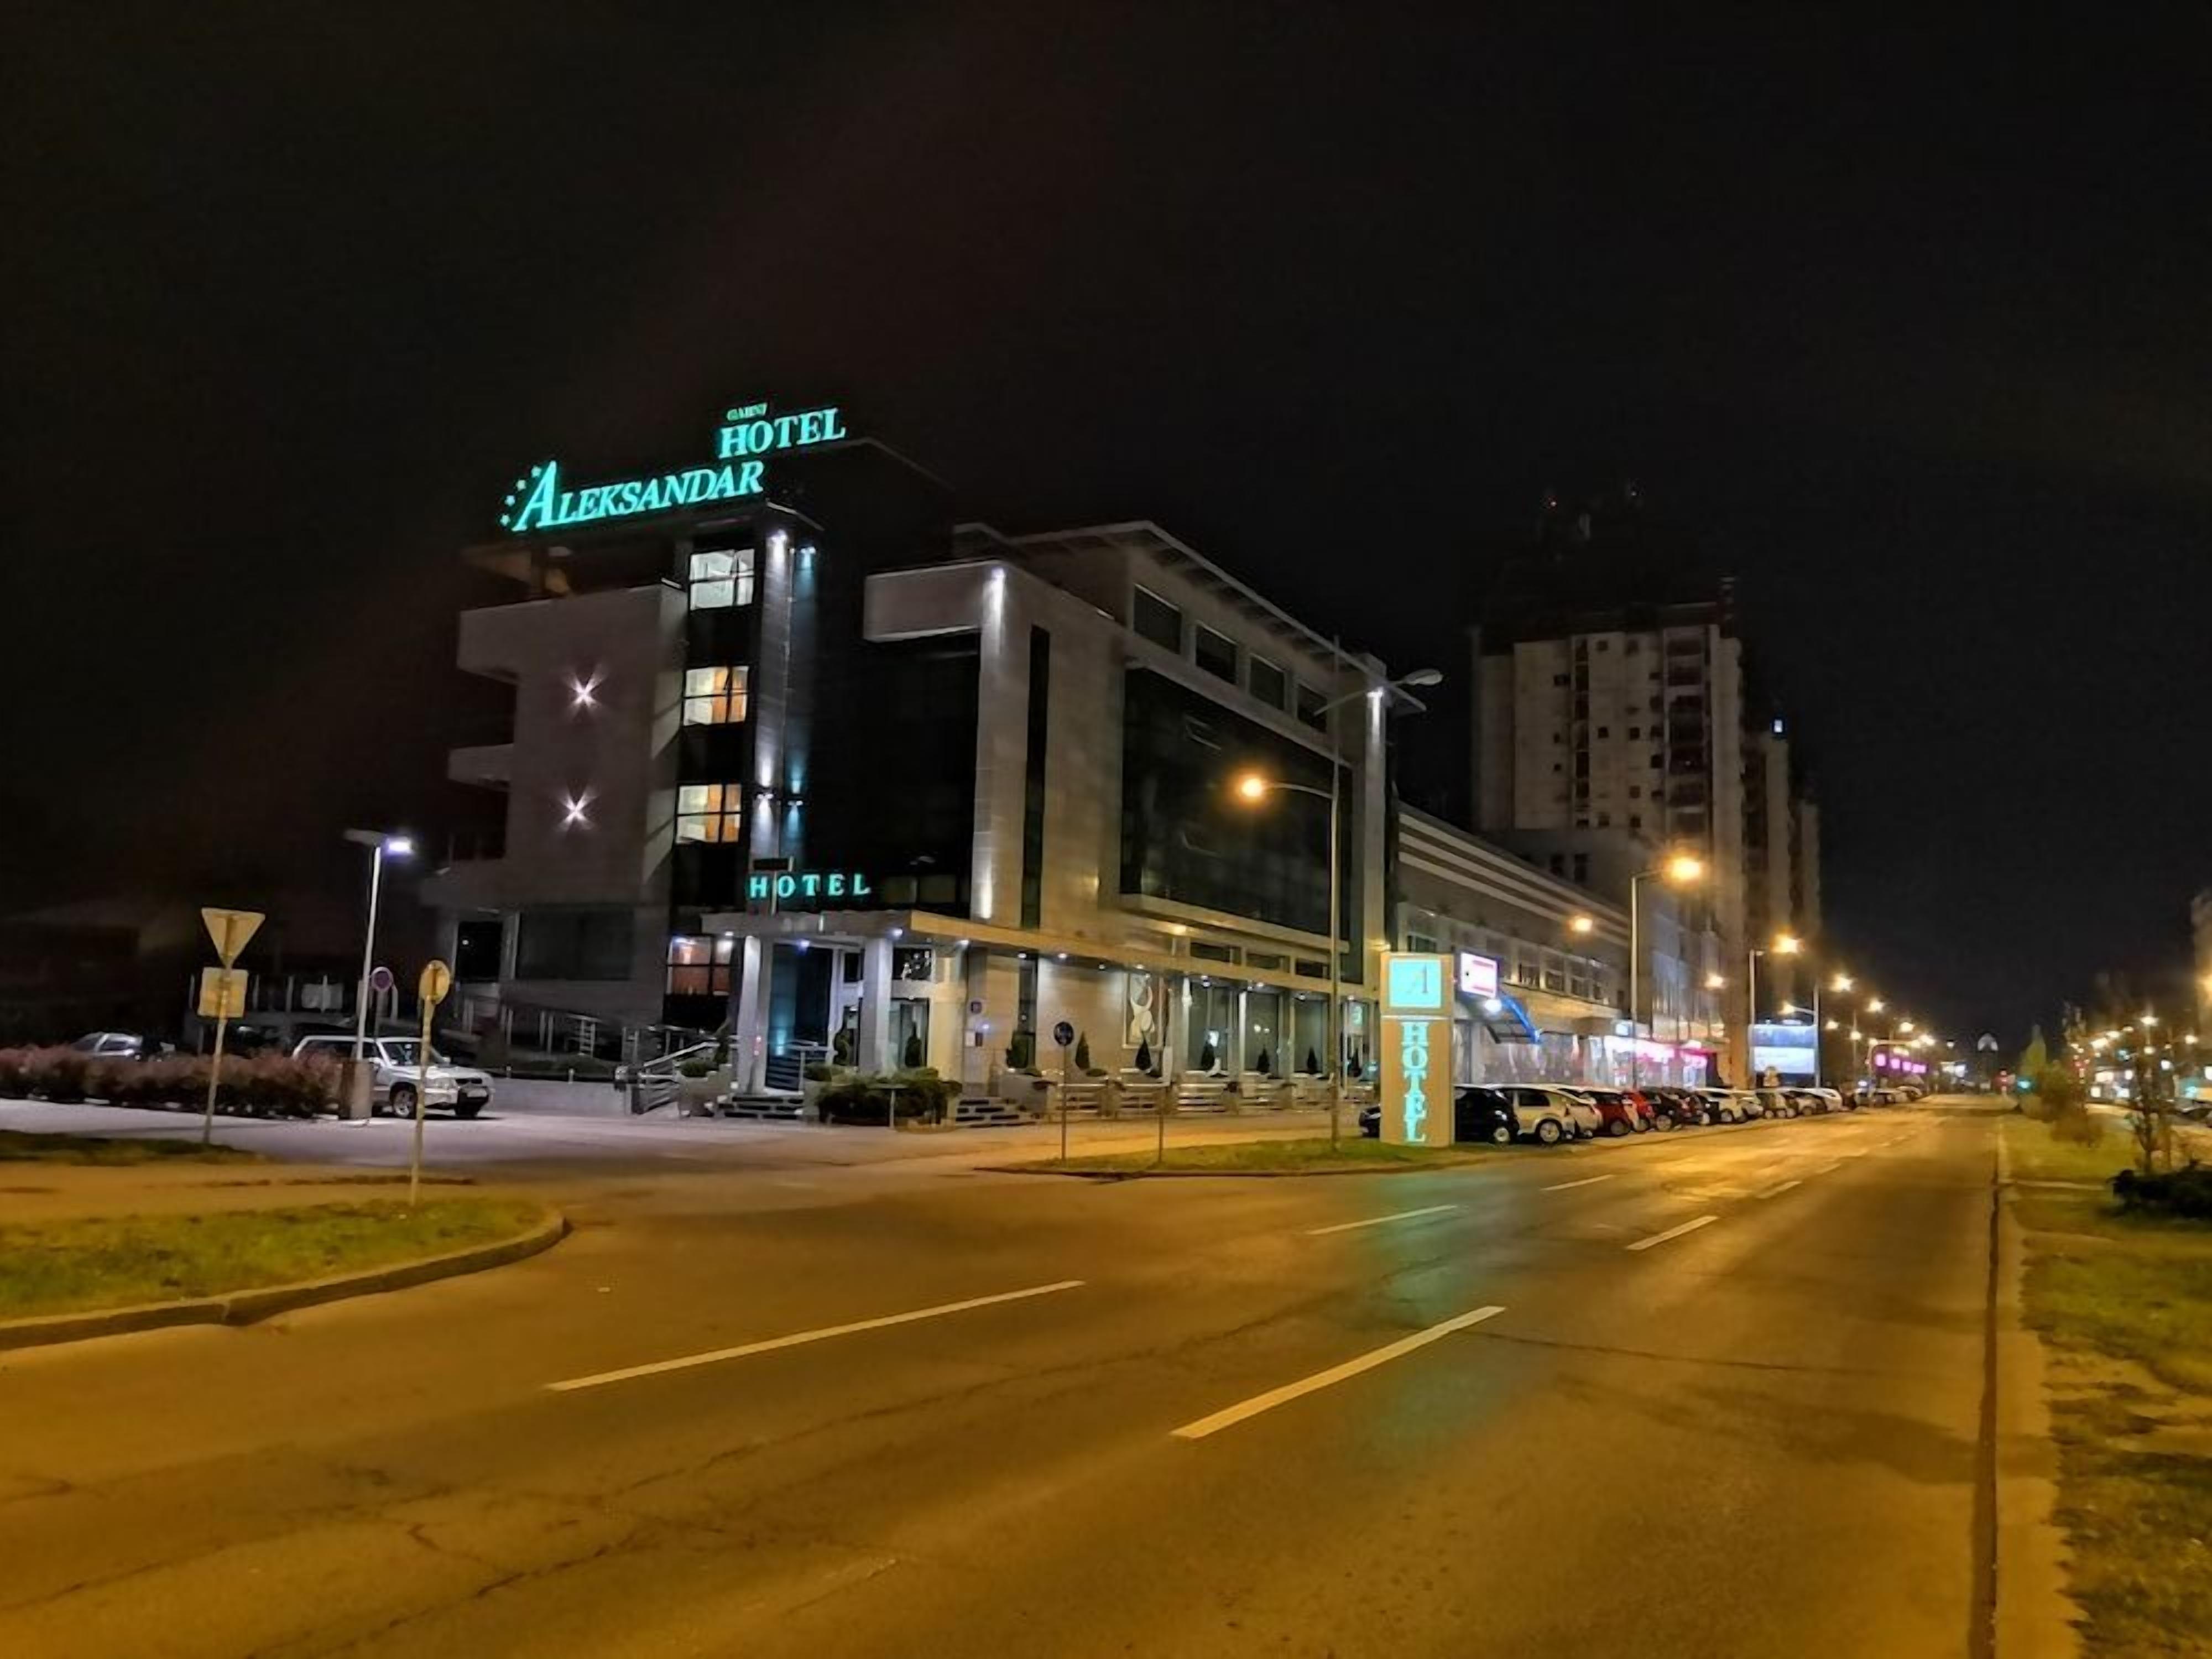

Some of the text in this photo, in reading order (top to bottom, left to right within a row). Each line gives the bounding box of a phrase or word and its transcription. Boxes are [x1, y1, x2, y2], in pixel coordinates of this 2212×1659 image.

[718, 408, 846, 459] HOTEL
[512, 460, 765, 531] ALEKSANDAR
[749, 873, 870, 899] HOTEL
[1401, 1021, 1429, 1142] HOTEL
